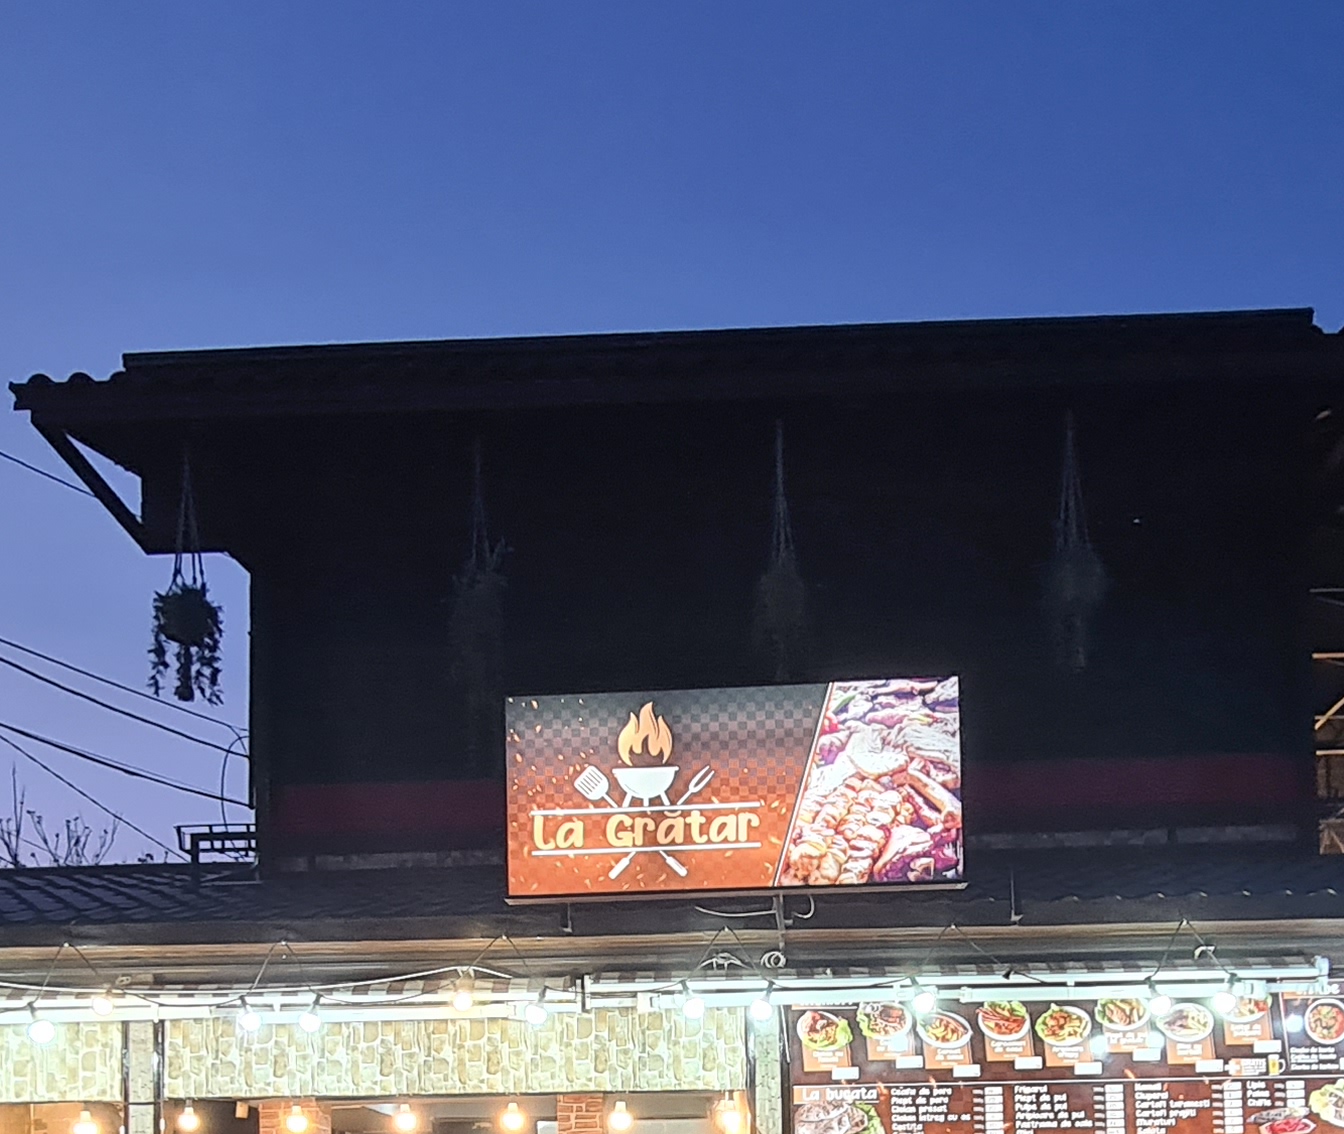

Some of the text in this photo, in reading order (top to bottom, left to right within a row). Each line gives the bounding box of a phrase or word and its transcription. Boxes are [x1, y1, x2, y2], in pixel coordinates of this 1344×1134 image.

[533, 810, 761, 850] La Grătar
[802, 1088, 820, 1101] La
